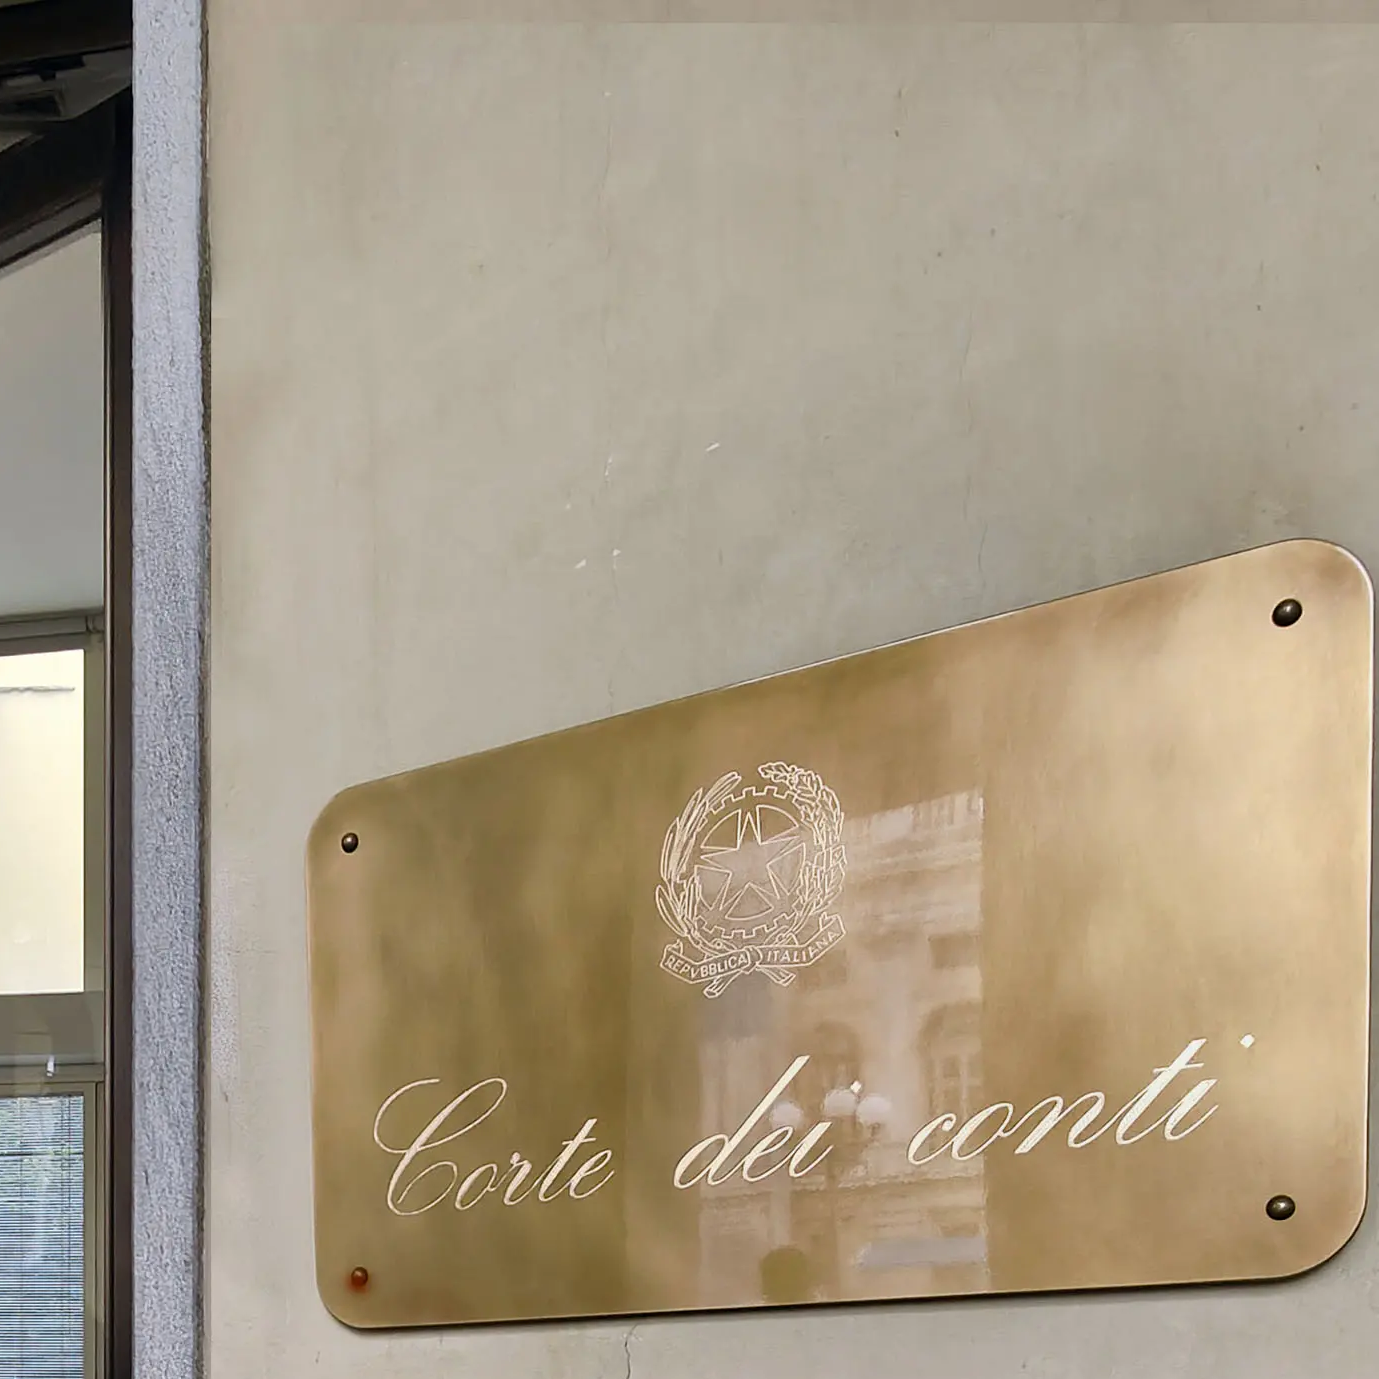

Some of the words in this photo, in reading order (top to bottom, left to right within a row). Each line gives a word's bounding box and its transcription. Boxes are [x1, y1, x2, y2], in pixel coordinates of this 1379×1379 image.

[664, 953, 749, 979] REPVBBLICA
[766, 930, 840, 962] ITALIANA
[374, 1077, 615, 1216] Corte
[673, 1054, 862, 1189] dei
[907, 1033, 1255, 1165] conti
